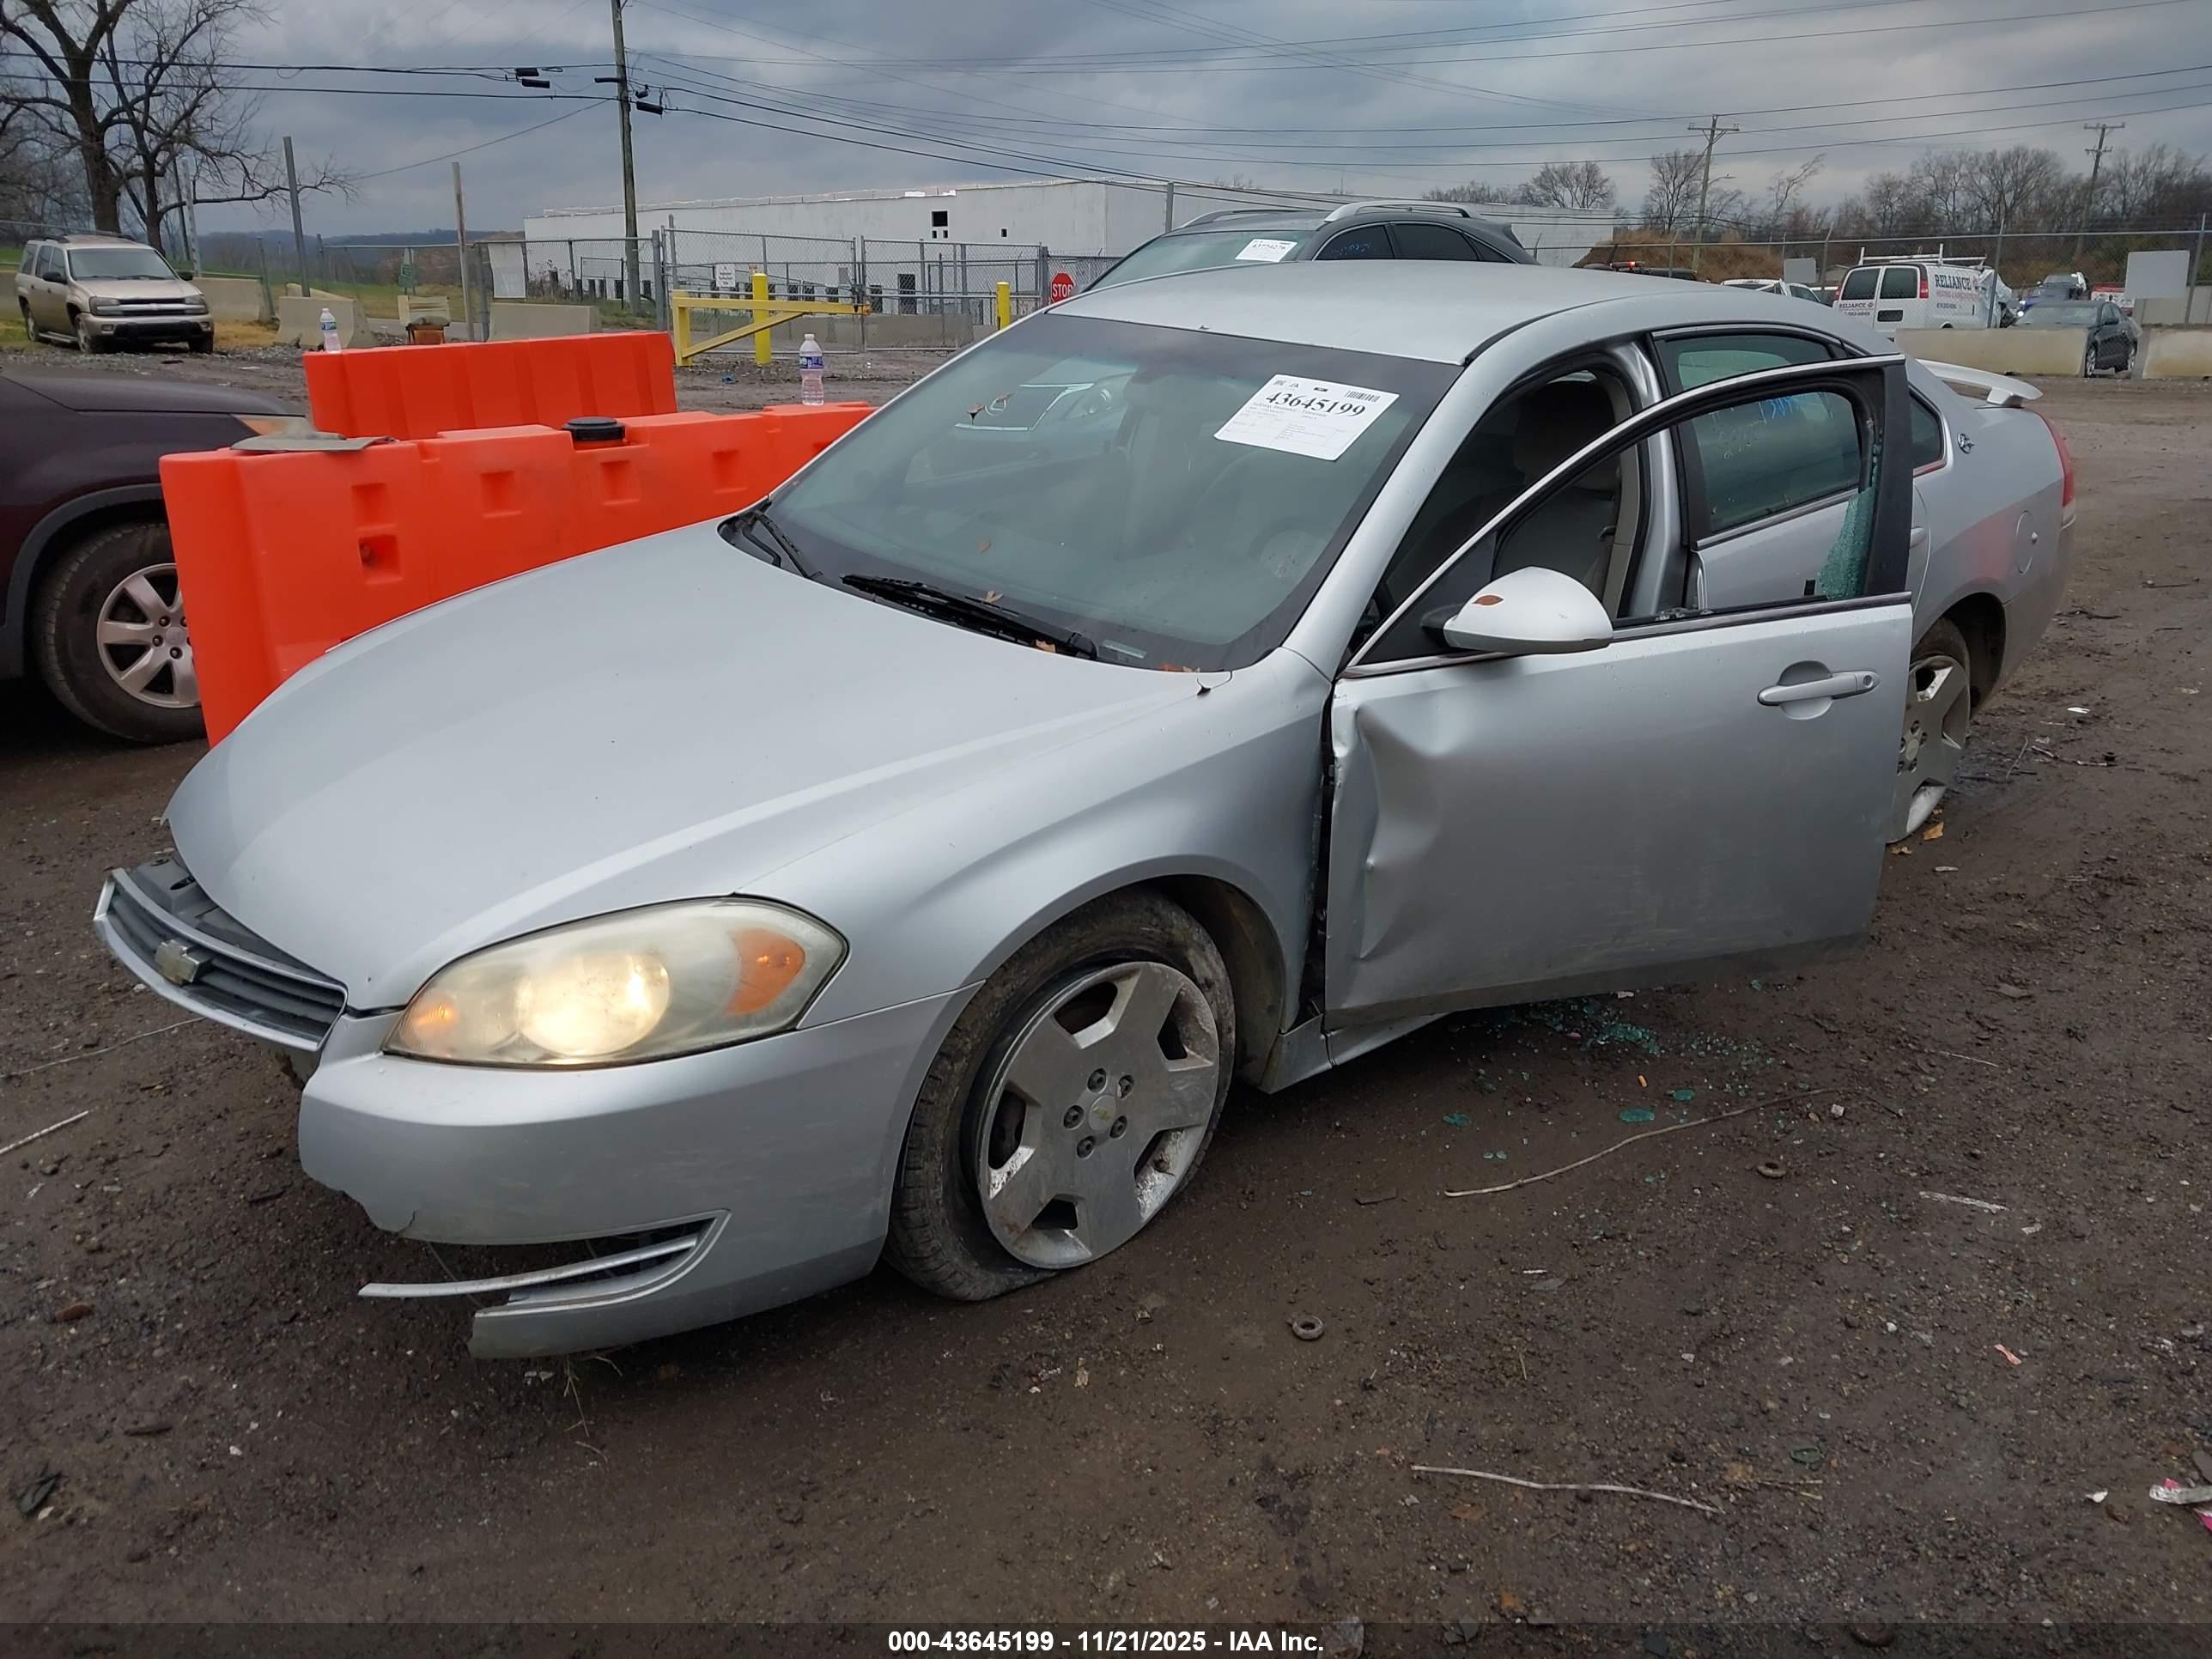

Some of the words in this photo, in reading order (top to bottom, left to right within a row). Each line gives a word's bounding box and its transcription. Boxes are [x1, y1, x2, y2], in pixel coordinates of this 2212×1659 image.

[1052, 283, 1073, 297] STOP
[1934, 274, 1972, 290] RELIANCE
[1266, 391, 1366, 417] 43645199
